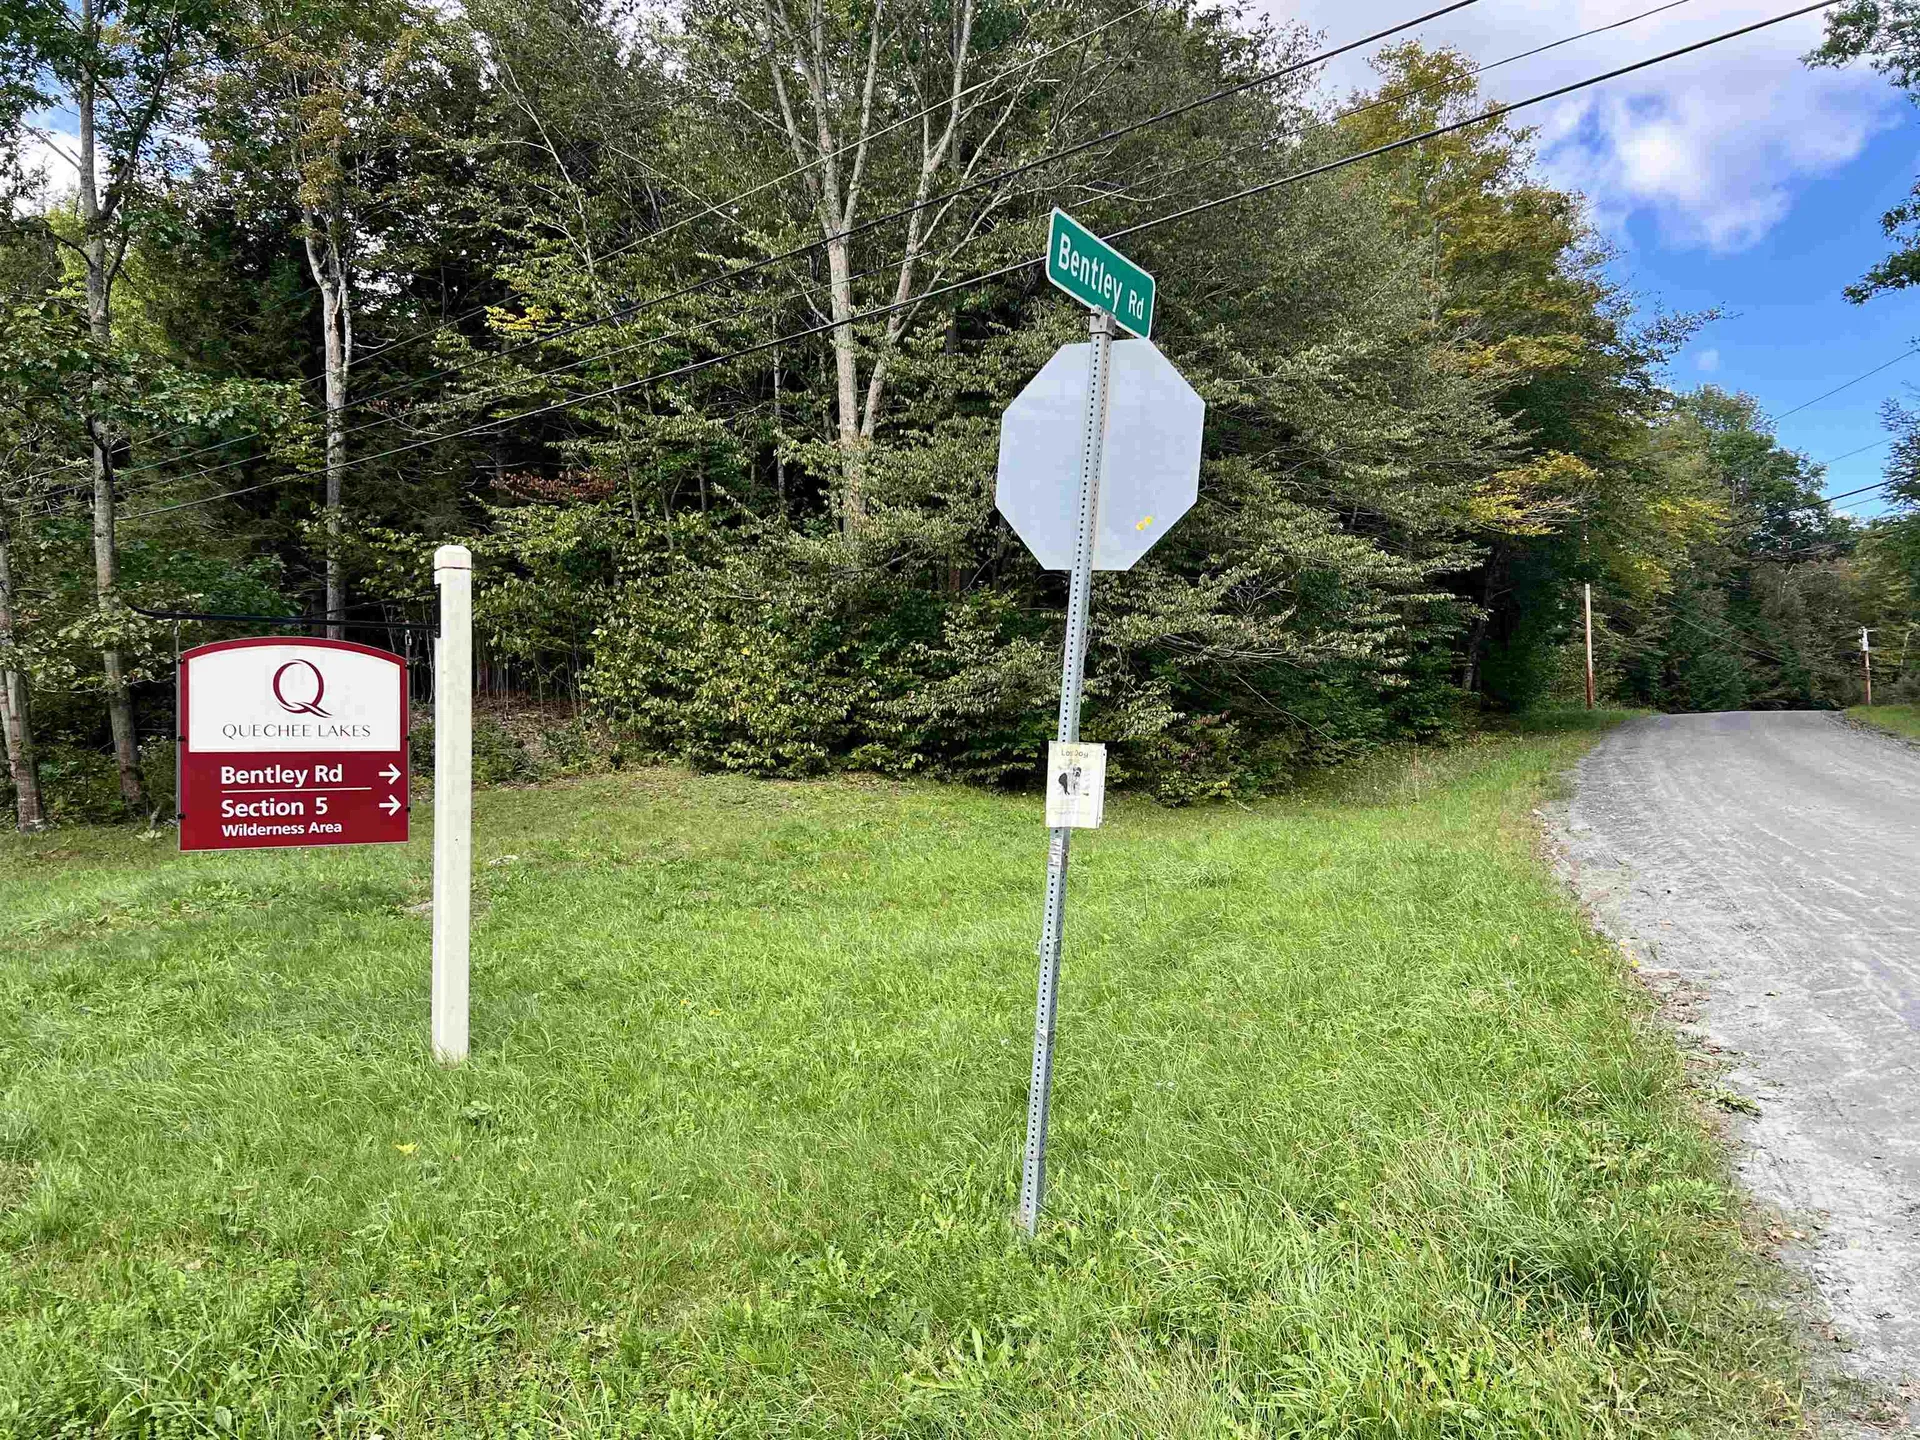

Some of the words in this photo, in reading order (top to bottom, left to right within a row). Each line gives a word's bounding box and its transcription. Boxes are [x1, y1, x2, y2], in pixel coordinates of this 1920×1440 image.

[1058, 232, 1122, 313] Bentley
[1128, 289, 1144, 320] Rd
[273, 659, 332, 718] Q
[222, 724, 310, 739] QUECHEE
[318, 724, 371, 737] LAKES
[221, 764, 308, 787] Bentley
[314, 764, 342, 782] Rd
[221, 798, 304, 817] Section
[315, 797, 328, 815] 5
[222, 823, 304, 836] Wilderness
[309, 821, 342, 834] Area
